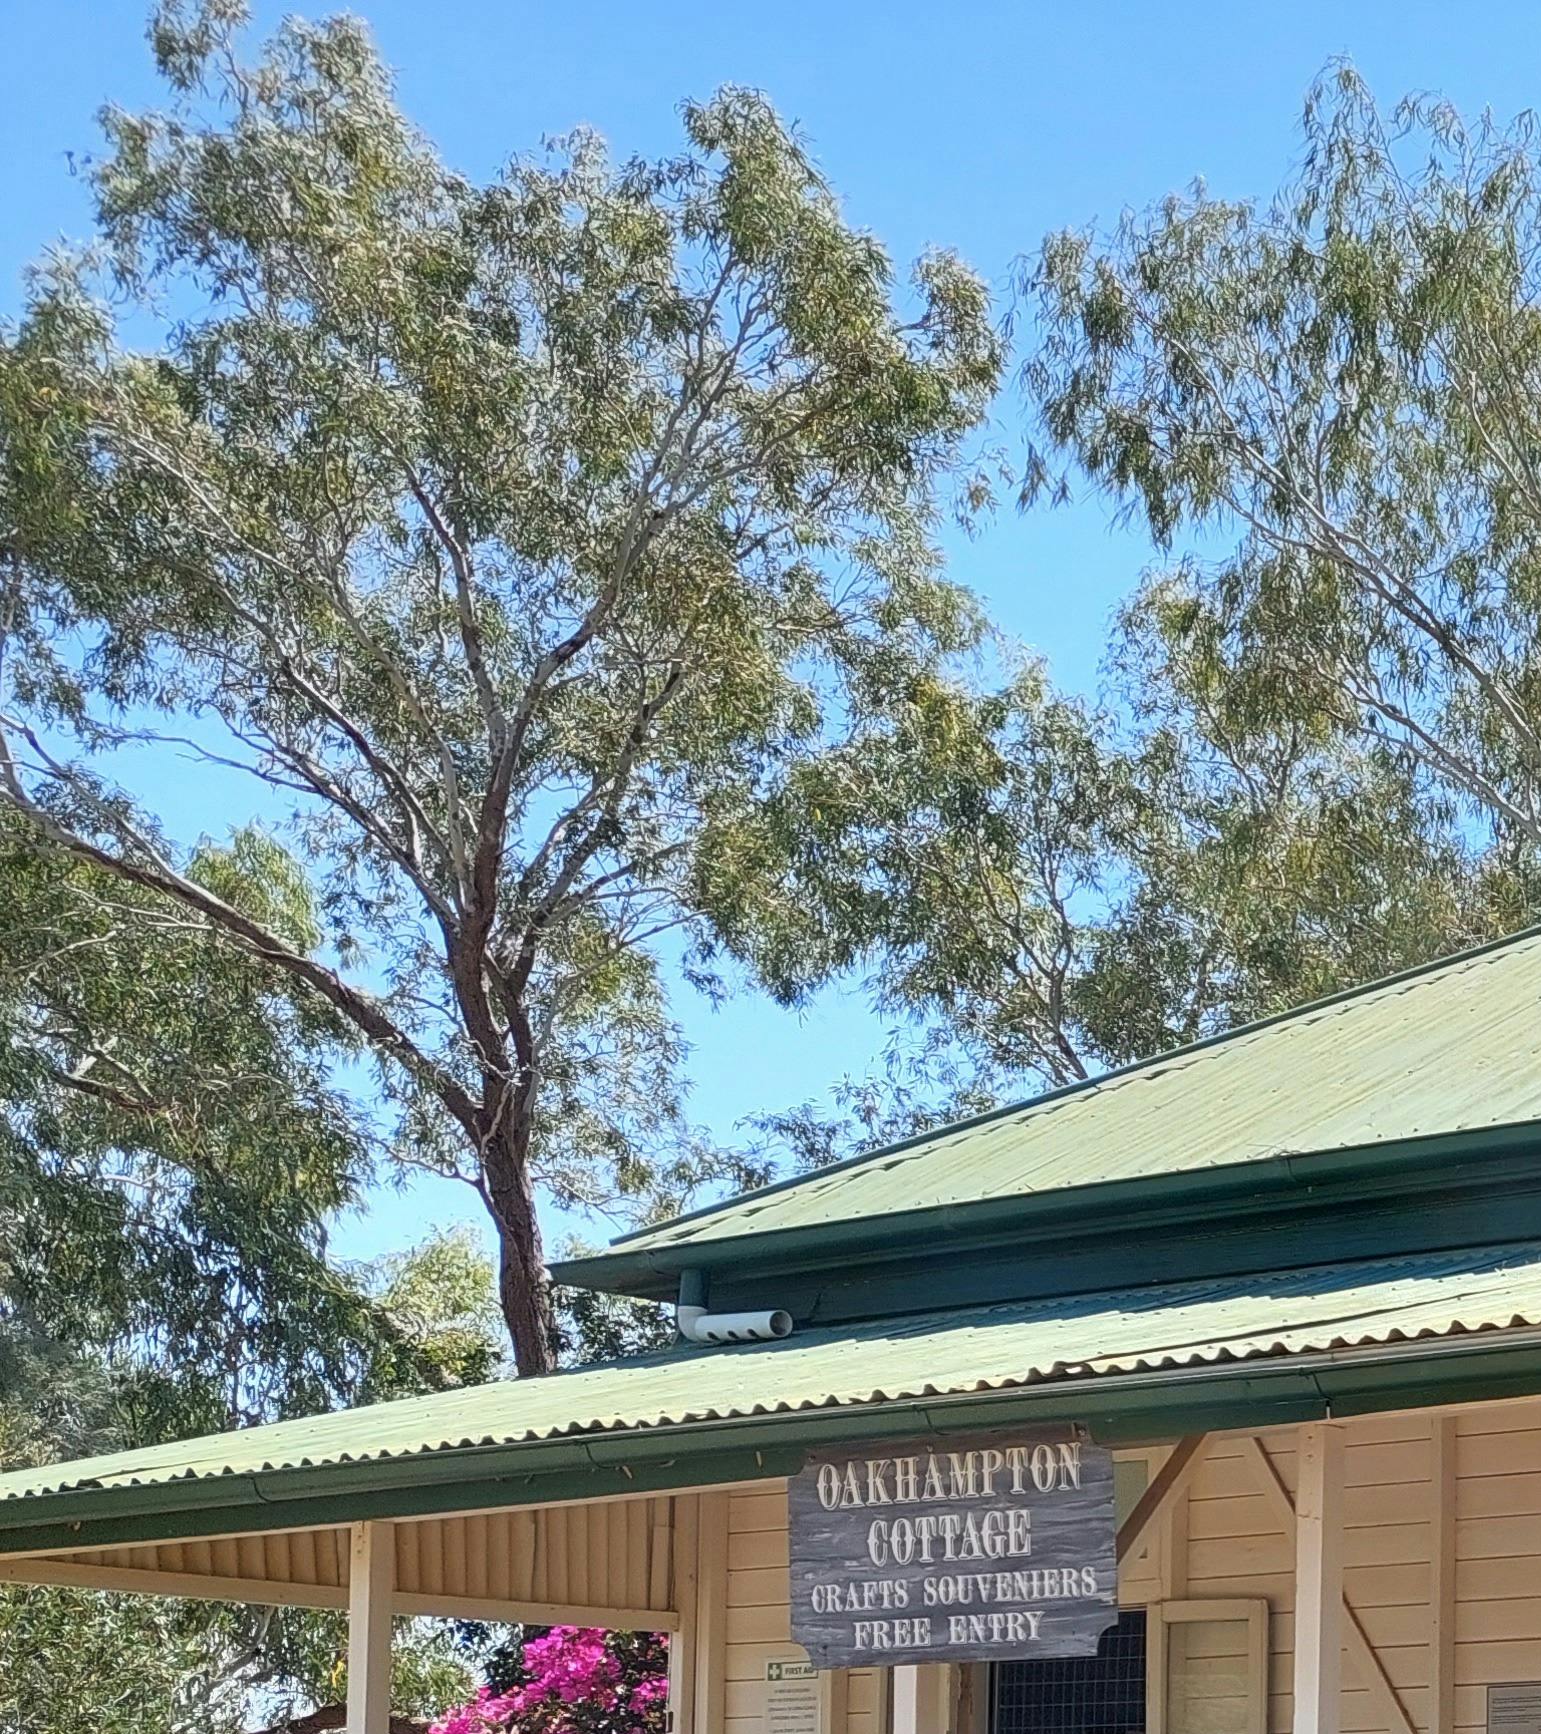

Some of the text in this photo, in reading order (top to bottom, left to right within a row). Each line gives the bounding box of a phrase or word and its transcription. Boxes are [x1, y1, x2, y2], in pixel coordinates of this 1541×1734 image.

[816, 1443, 1081, 1510] OAKHAMPTON
[867, 1510, 1032, 1566] COTTAGE
[811, 1567, 1098, 1613] CRAFTS SOUVENIERS
[853, 1611, 1044, 1650] FREE ENTRY
[785, 1666, 802, 1675] FIRST
